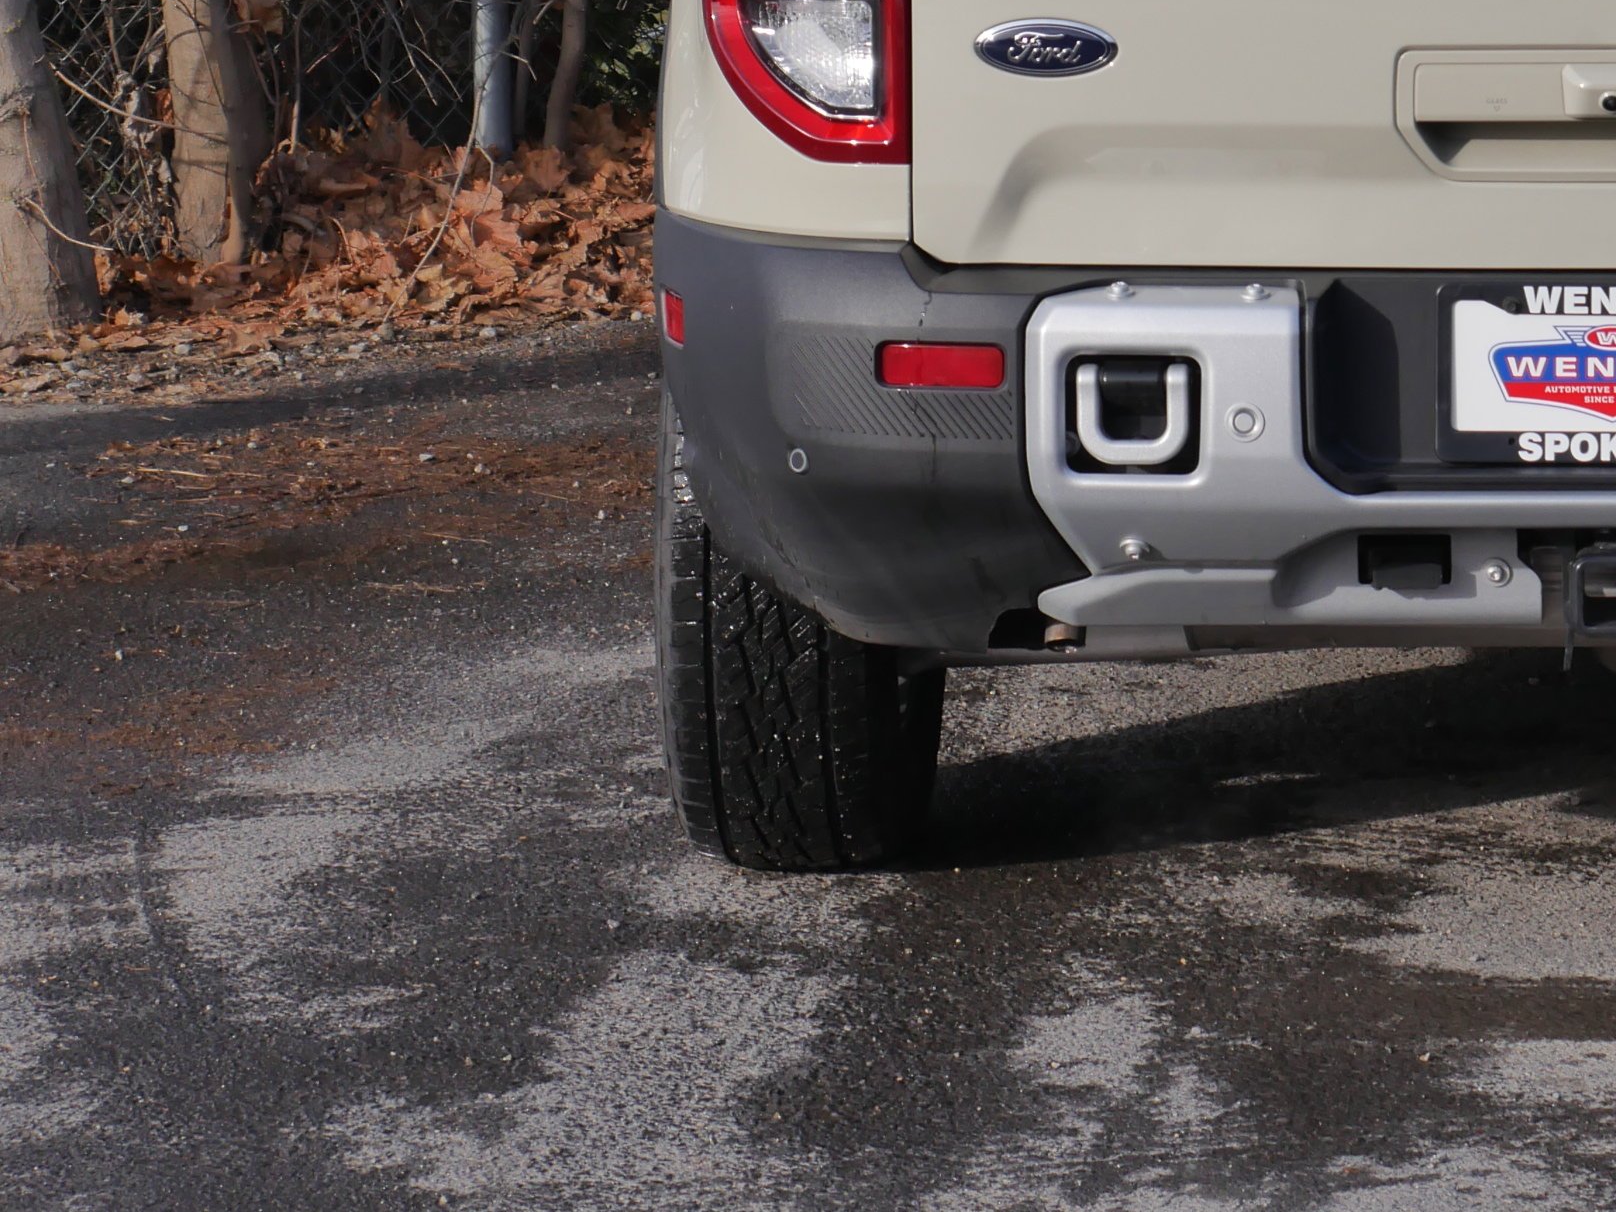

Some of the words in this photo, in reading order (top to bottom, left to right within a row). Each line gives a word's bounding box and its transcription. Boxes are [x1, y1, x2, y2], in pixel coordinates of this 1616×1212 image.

[1007, 31, 1081, 64] Ford
[1544, 385, 1610, 394] AUTOMOTIVE
[1584, 396, 1615, 404] SINCE
